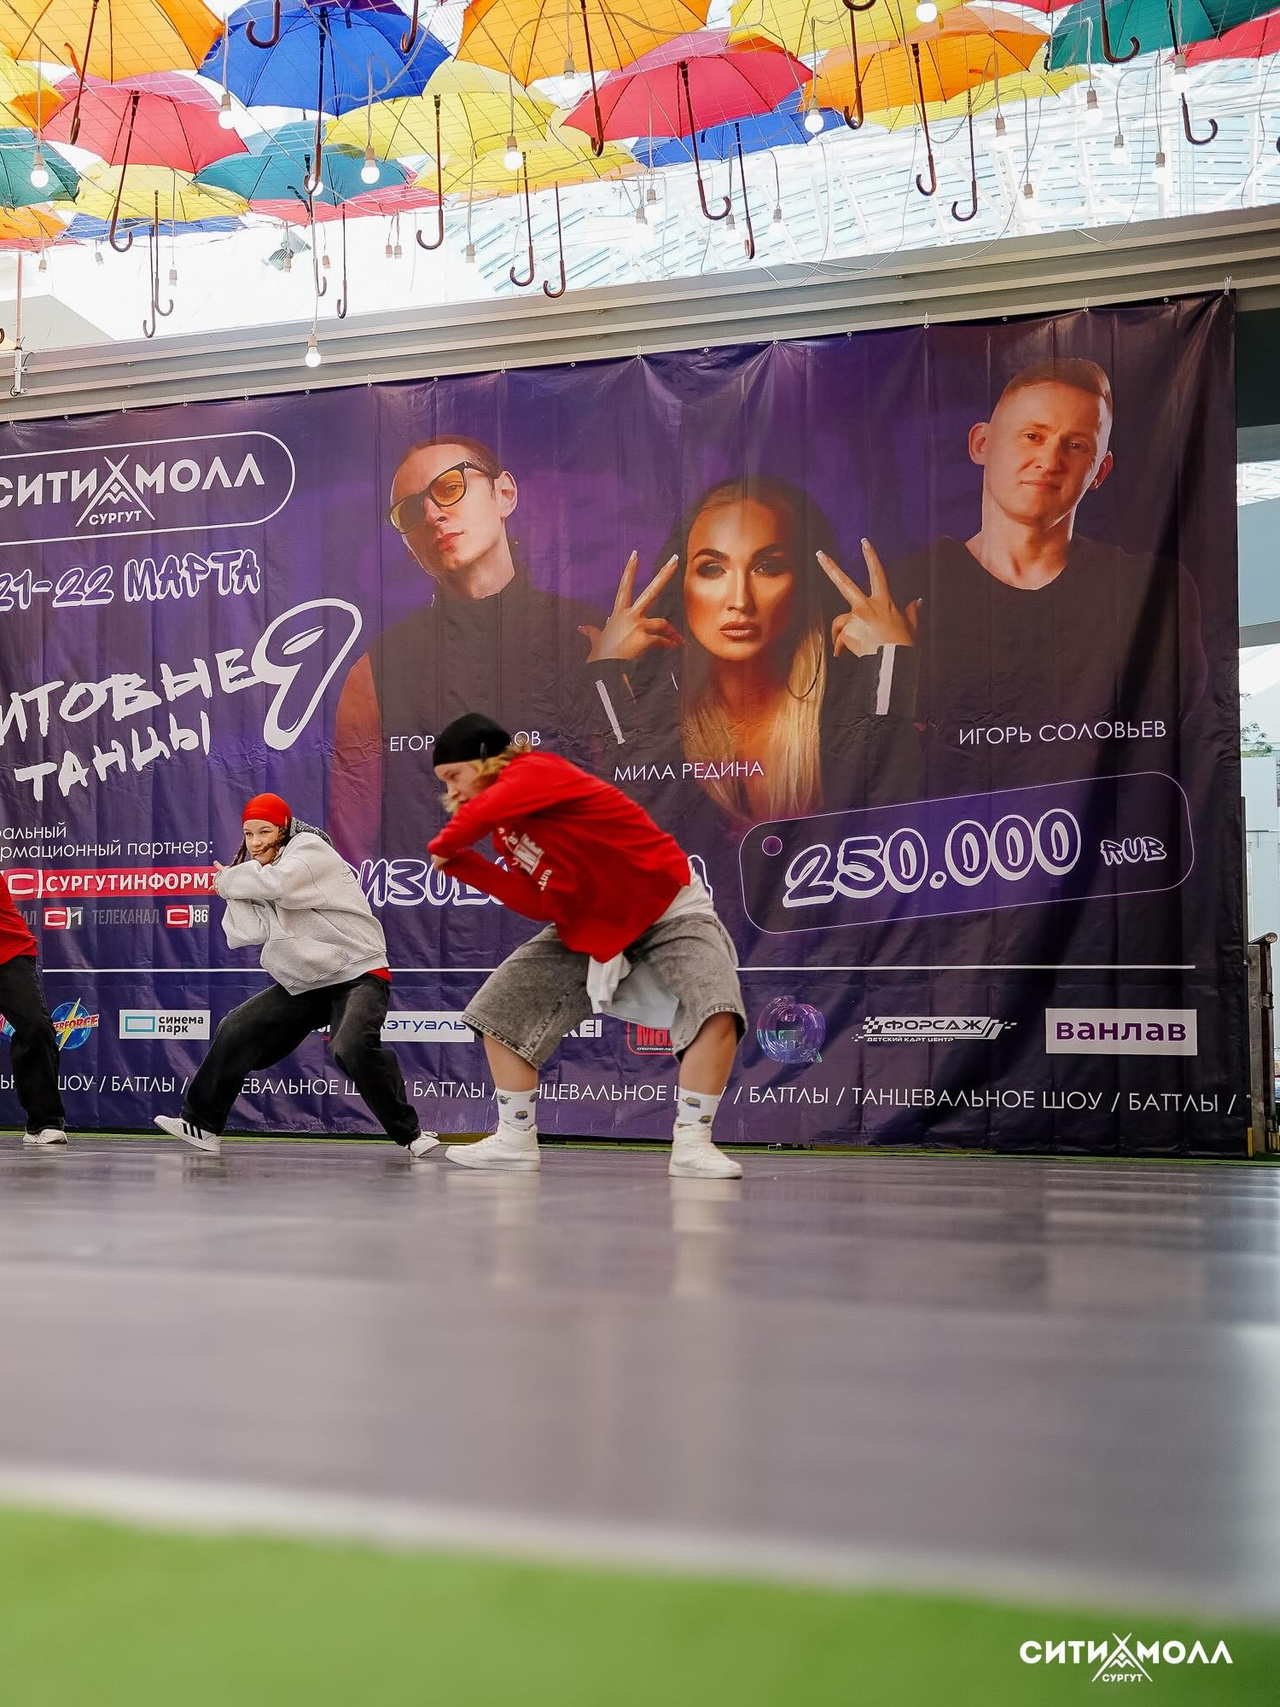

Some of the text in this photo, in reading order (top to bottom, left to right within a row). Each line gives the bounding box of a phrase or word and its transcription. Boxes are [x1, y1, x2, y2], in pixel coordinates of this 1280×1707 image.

[135, 453, 265, 495] МОЛЛ
[88, 510, 143, 527] СУРГУТ
[124, 549, 262, 602] МАРТА
[958, 720, 1167, 746] ИГОРЬ СОЛОВЬЕВ
[390, 735, 435, 752] ЕГОР
[14, 710, 212, 801] ТАНЦЫ
[614, 761, 764, 782] МИЛА РЕДИНА
[127, 839, 215, 859] партнер:
[782, 807, 1082, 908] 250.000
[1100, 836, 1167, 865] RUB
[46, 872, 217, 892] СУРГУТИНФОРМТ
[91, 908, 160, 926] ТЕЛЕКАНАЛ
[158, 1015, 204, 1025] синема
[158, 1023, 189, 1035] парк
[884, 1019, 983, 1031] ФОРСАЖ
[1055, 1021, 1188, 1042] ванлав
[111, 1076, 176, 1092] БАТТЛЫ
[238, 1078, 339, 1095] ЕВАЛЬНОЕ
[412, 1081, 486, 1099] БАТТЛЫ
[536, 1083, 667, 1101] НЦЕВАЛЬНОЕ
[749, 1086, 829, 1105] БАТТЛЫ
[852, 1087, 1035, 1108] ТАНЦЕВАЛЬНОЕ
[1042, 1091, 1103, 1111] ШОУ
[1128, 1093, 1219, 1113] БАТТЛЫ
